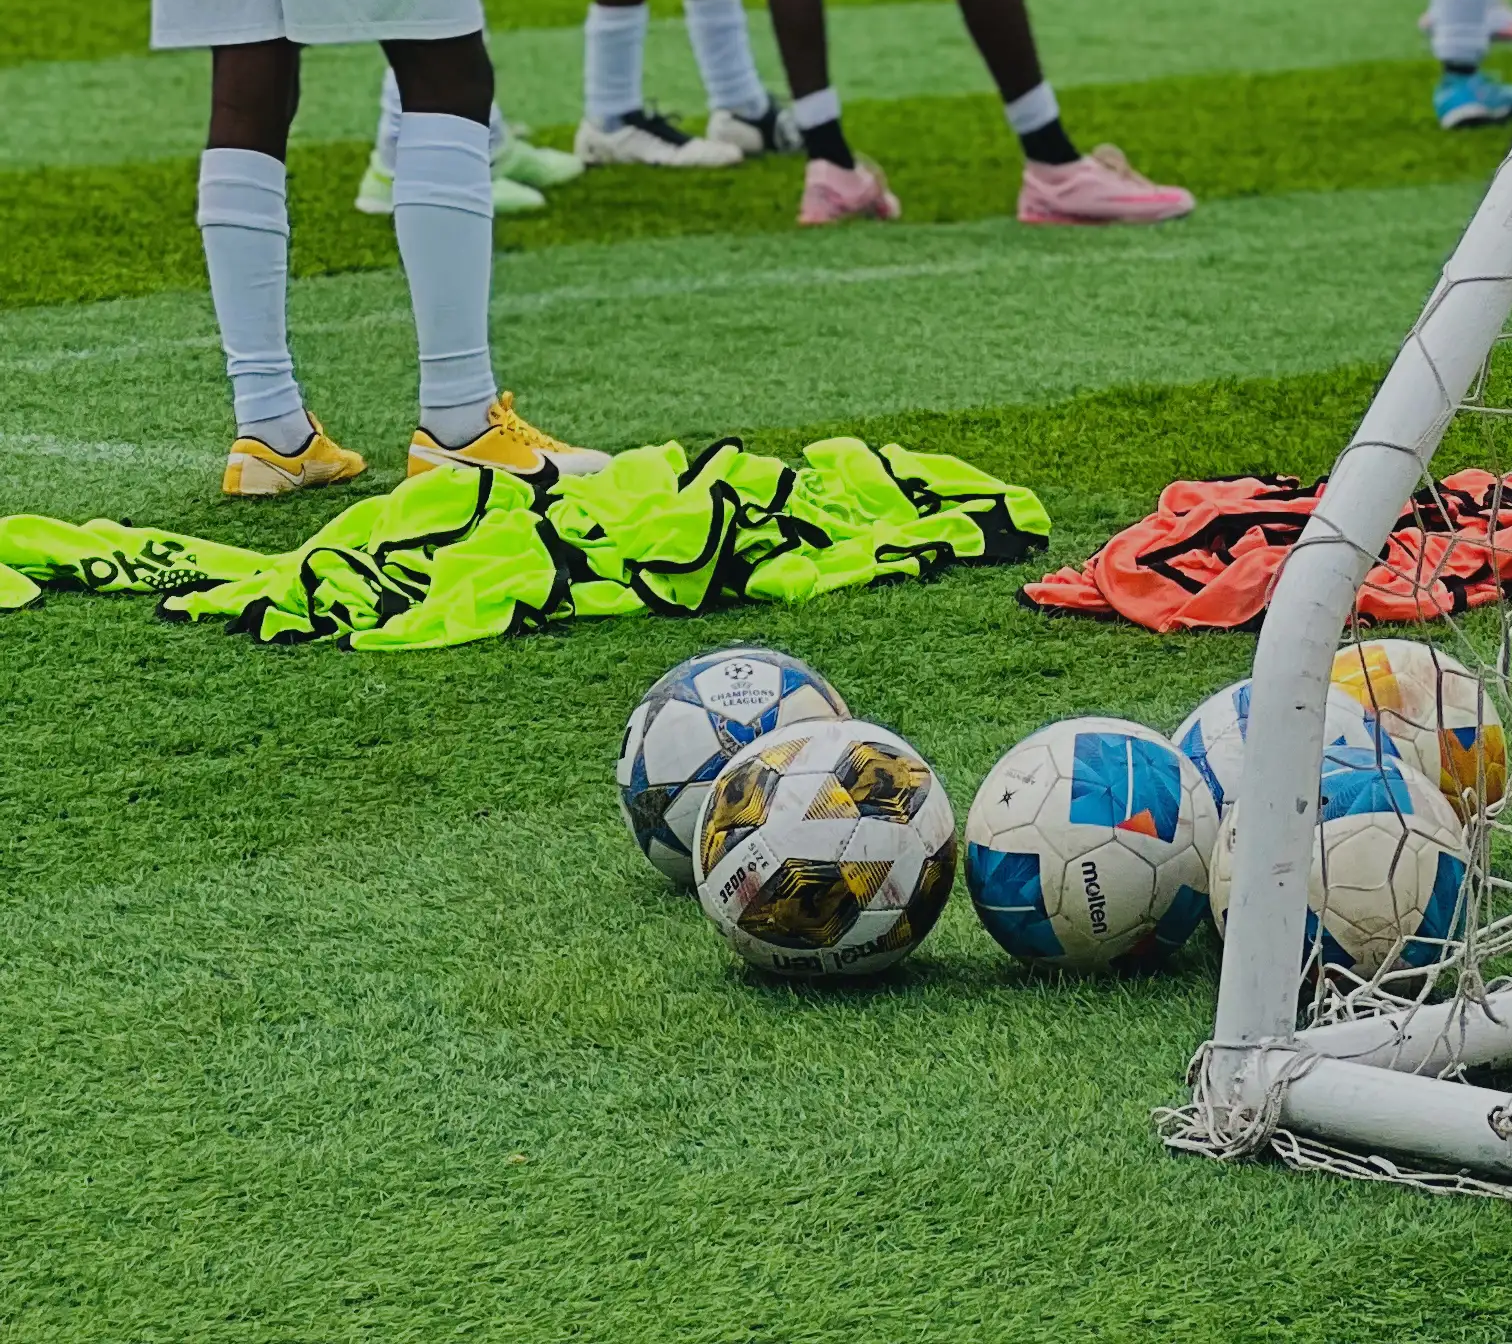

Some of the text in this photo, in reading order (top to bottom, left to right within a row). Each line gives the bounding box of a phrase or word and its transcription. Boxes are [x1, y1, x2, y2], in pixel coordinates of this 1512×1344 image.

[711, 689, 775, 702] CHAMPIONS
[722, 697, 766, 707] LEAGUE
[748, 842, 770, 870] SIZE
[720, 866, 747, 904] 3200
[1081, 861, 1107, 934] molten
